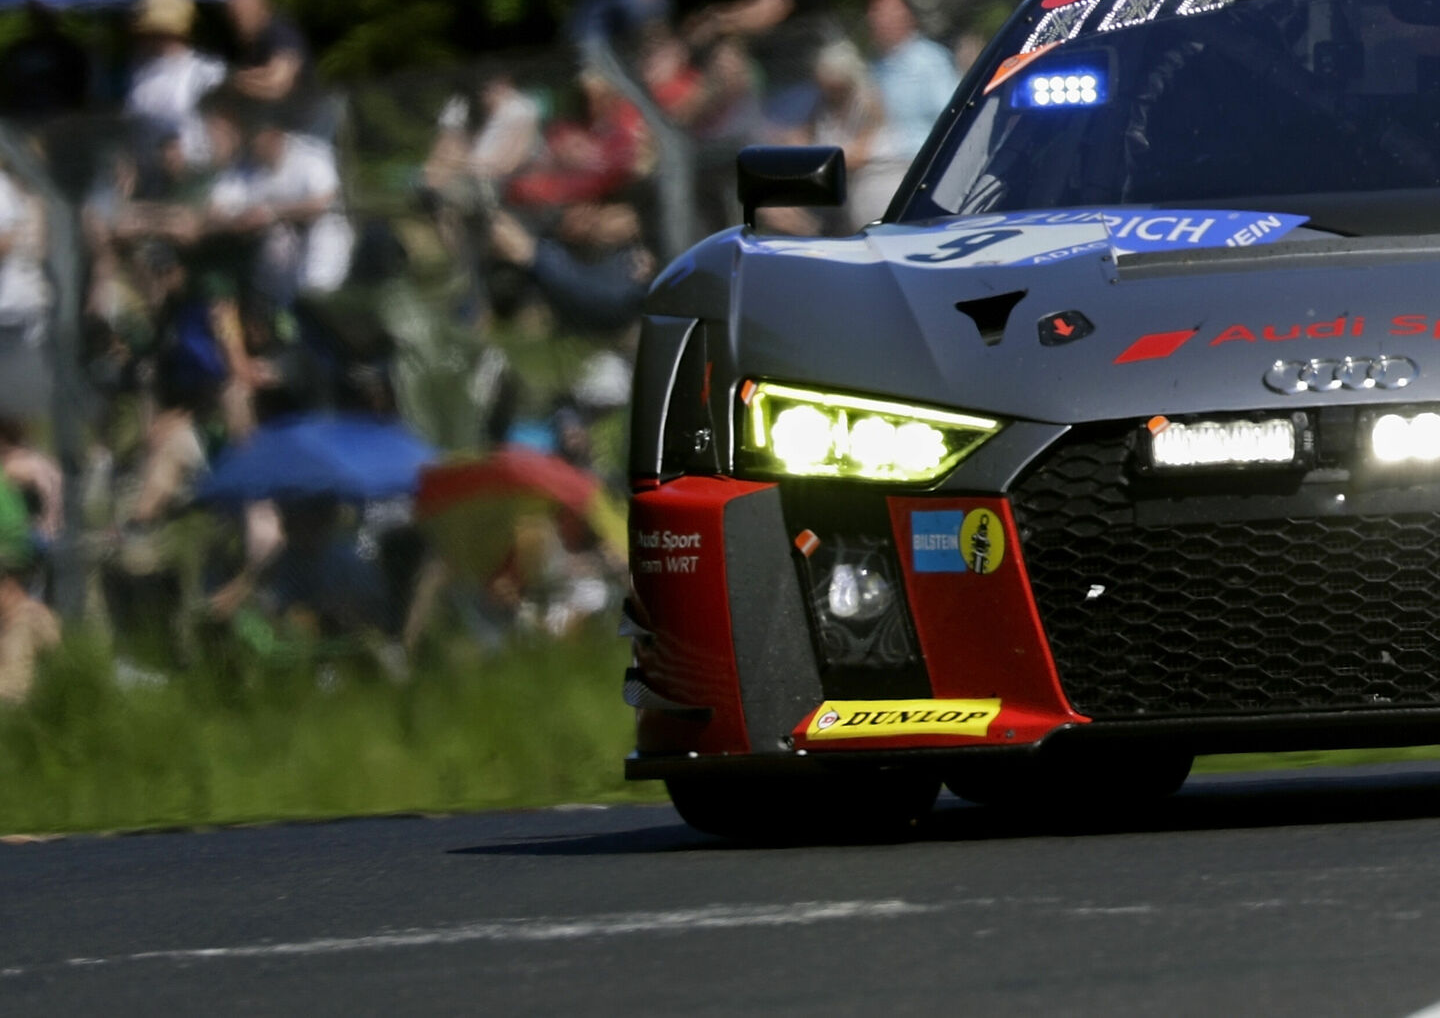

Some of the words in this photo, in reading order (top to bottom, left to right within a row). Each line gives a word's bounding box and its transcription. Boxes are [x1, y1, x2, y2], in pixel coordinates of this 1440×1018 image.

[905, 229, 1024, 263] 9
[1208, 315, 1366, 347] Audi
[661, 530, 702, 552] Sport
[664, 556, 700, 574] WRT
[841, 710, 989, 726] DUNLOP
